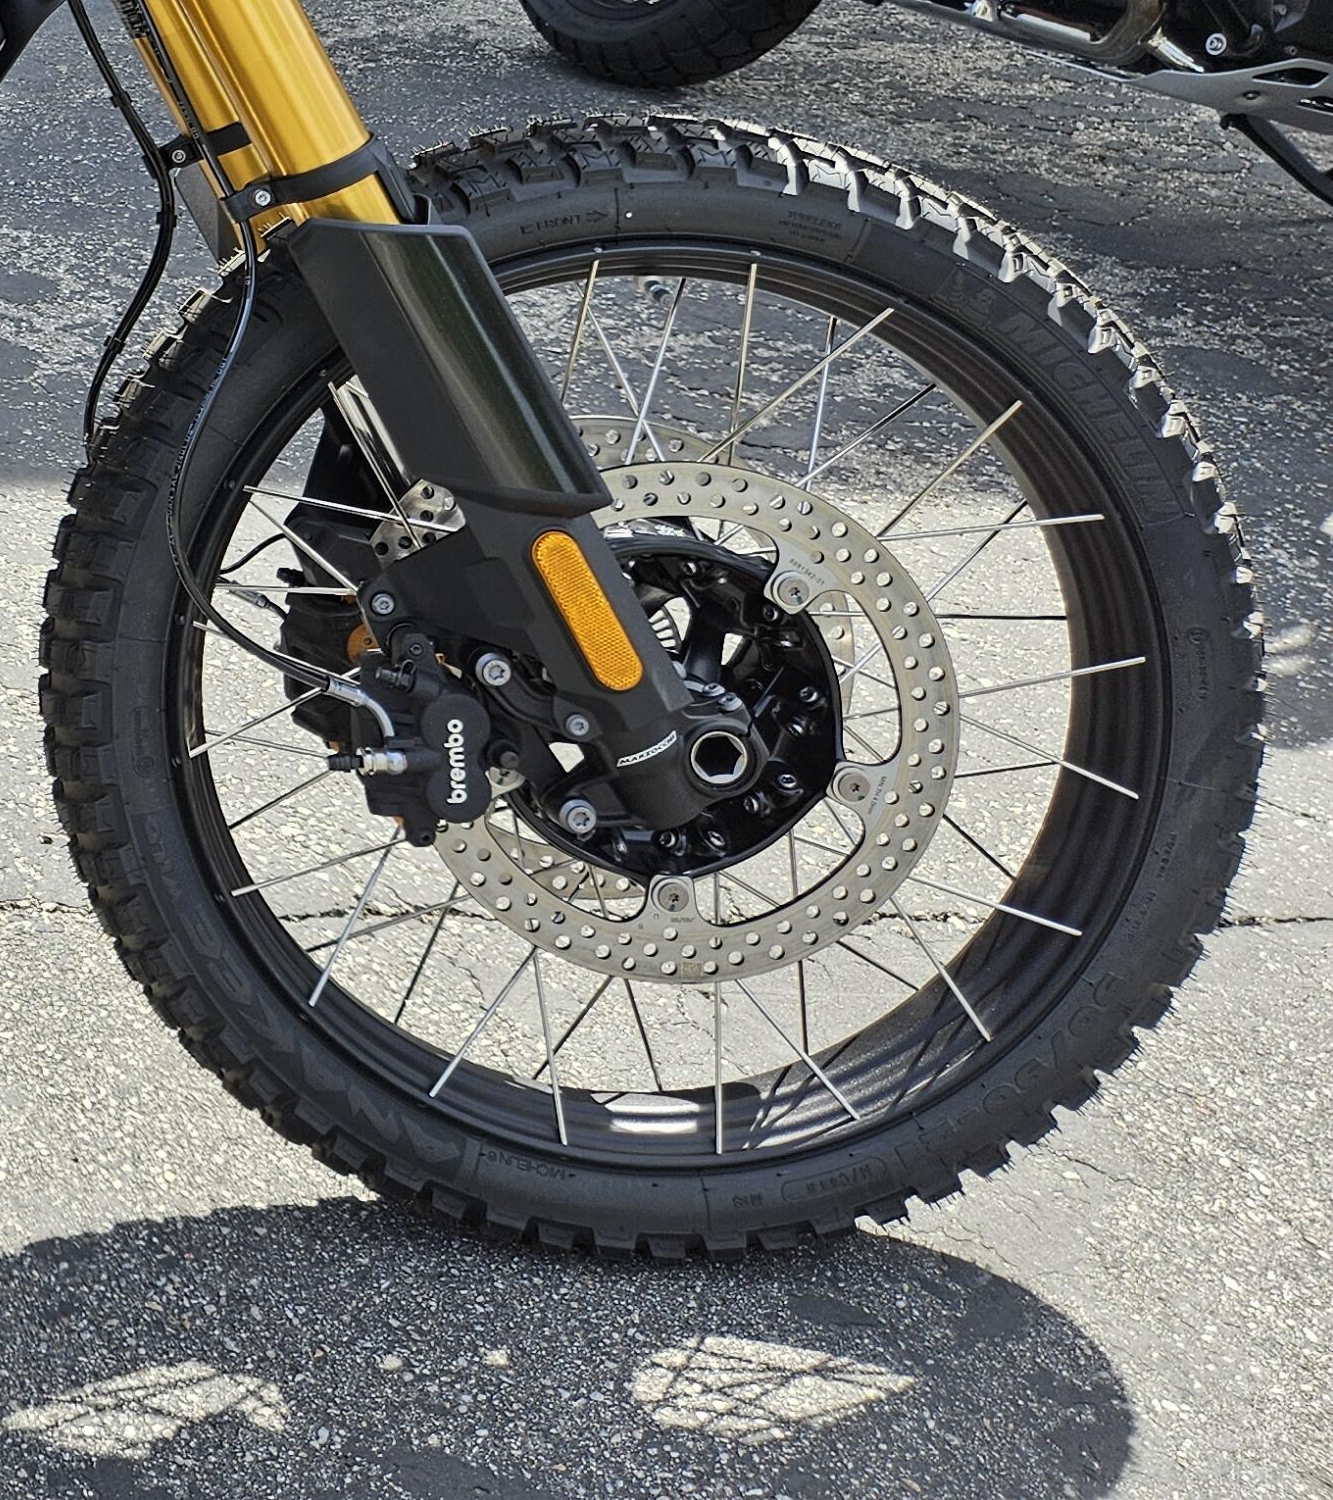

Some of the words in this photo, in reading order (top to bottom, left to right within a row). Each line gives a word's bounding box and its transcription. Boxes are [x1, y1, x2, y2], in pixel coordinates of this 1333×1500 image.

[536, 214, 581, 231] FRONT
[995, 308, 1181, 521] MICHELIN
[444, 718, 468, 804] brembo
